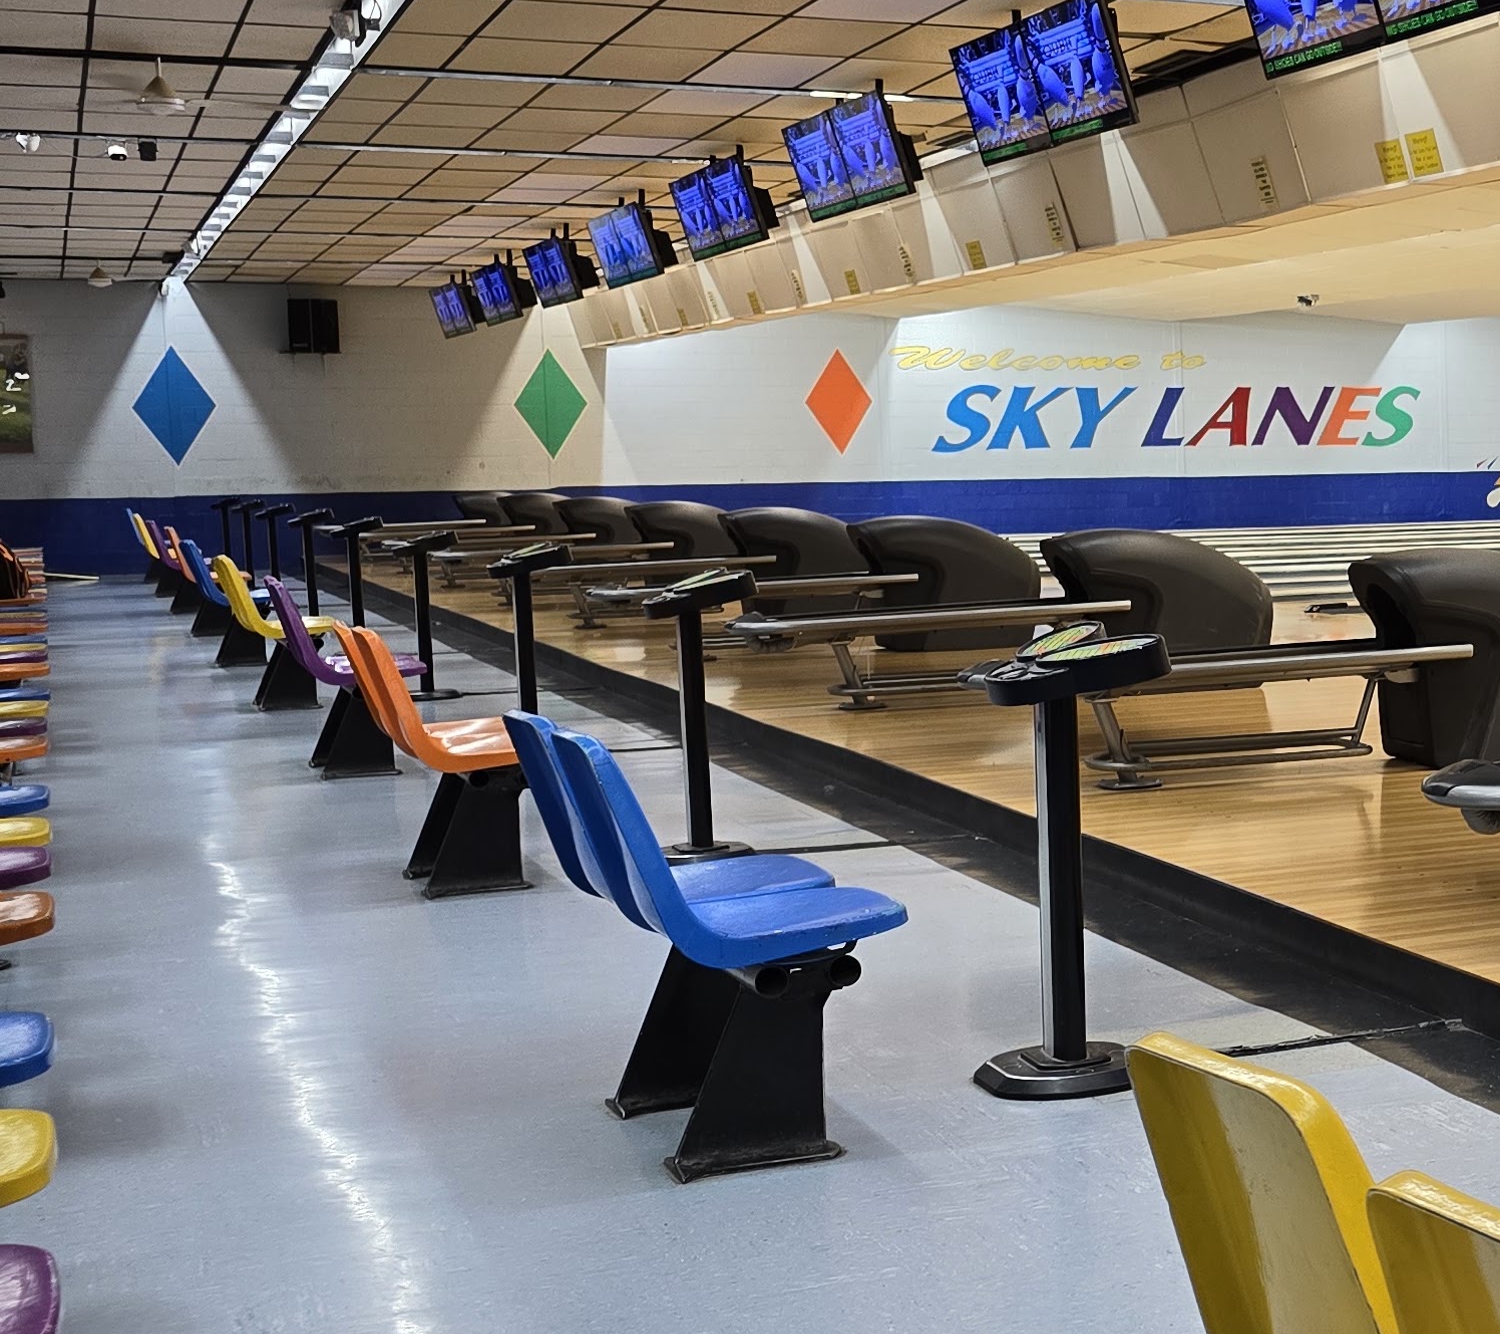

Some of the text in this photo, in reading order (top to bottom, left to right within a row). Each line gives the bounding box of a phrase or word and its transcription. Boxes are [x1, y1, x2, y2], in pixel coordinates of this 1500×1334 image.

[888, 346, 1206, 371] Welcome to
[931, 384, 1421, 453] SKY LANES
